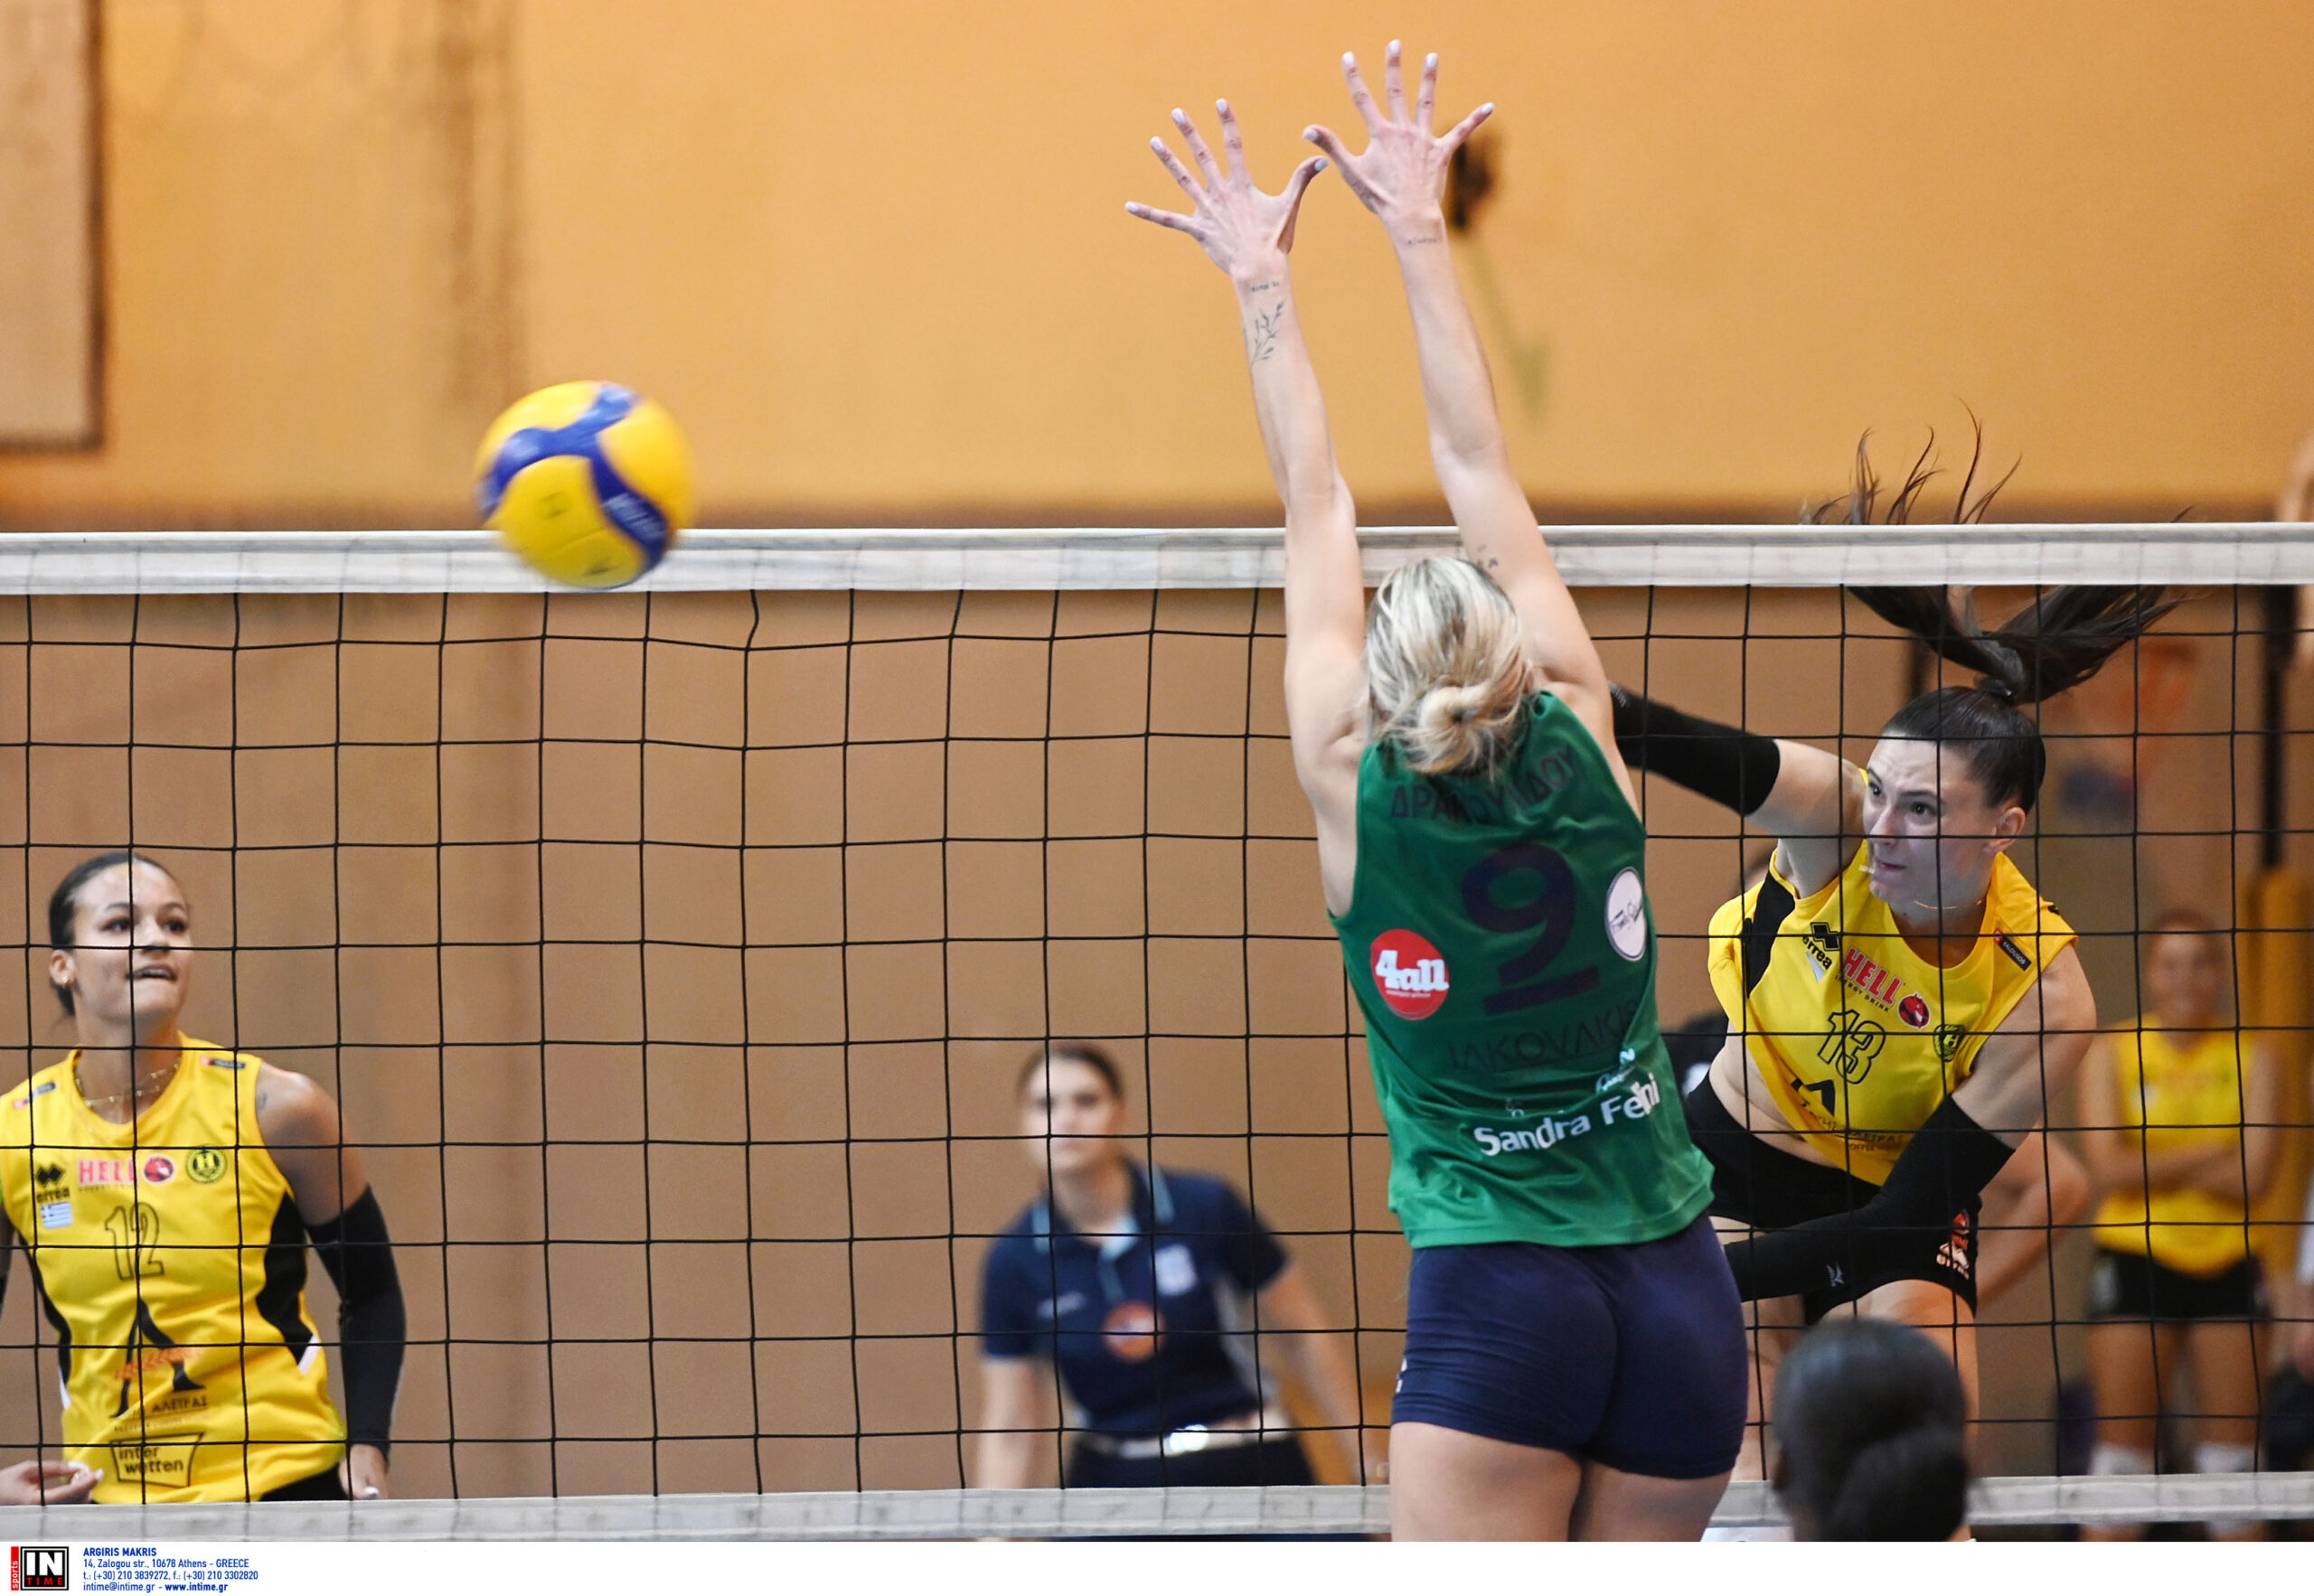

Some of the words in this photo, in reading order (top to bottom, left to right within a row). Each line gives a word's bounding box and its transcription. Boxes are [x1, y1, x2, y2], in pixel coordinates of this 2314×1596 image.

[1462, 840, 1576, 988] 9
[1375, 949, 1450, 991] 4all
[1844, 947, 1903, 1006] HELL
[1817, 1009, 1886, 1084] 13
[1474, 1115, 1591, 1156] Sandra
[104, 1202, 165, 1281] 12
[118, 1447, 160, 1460] inter
